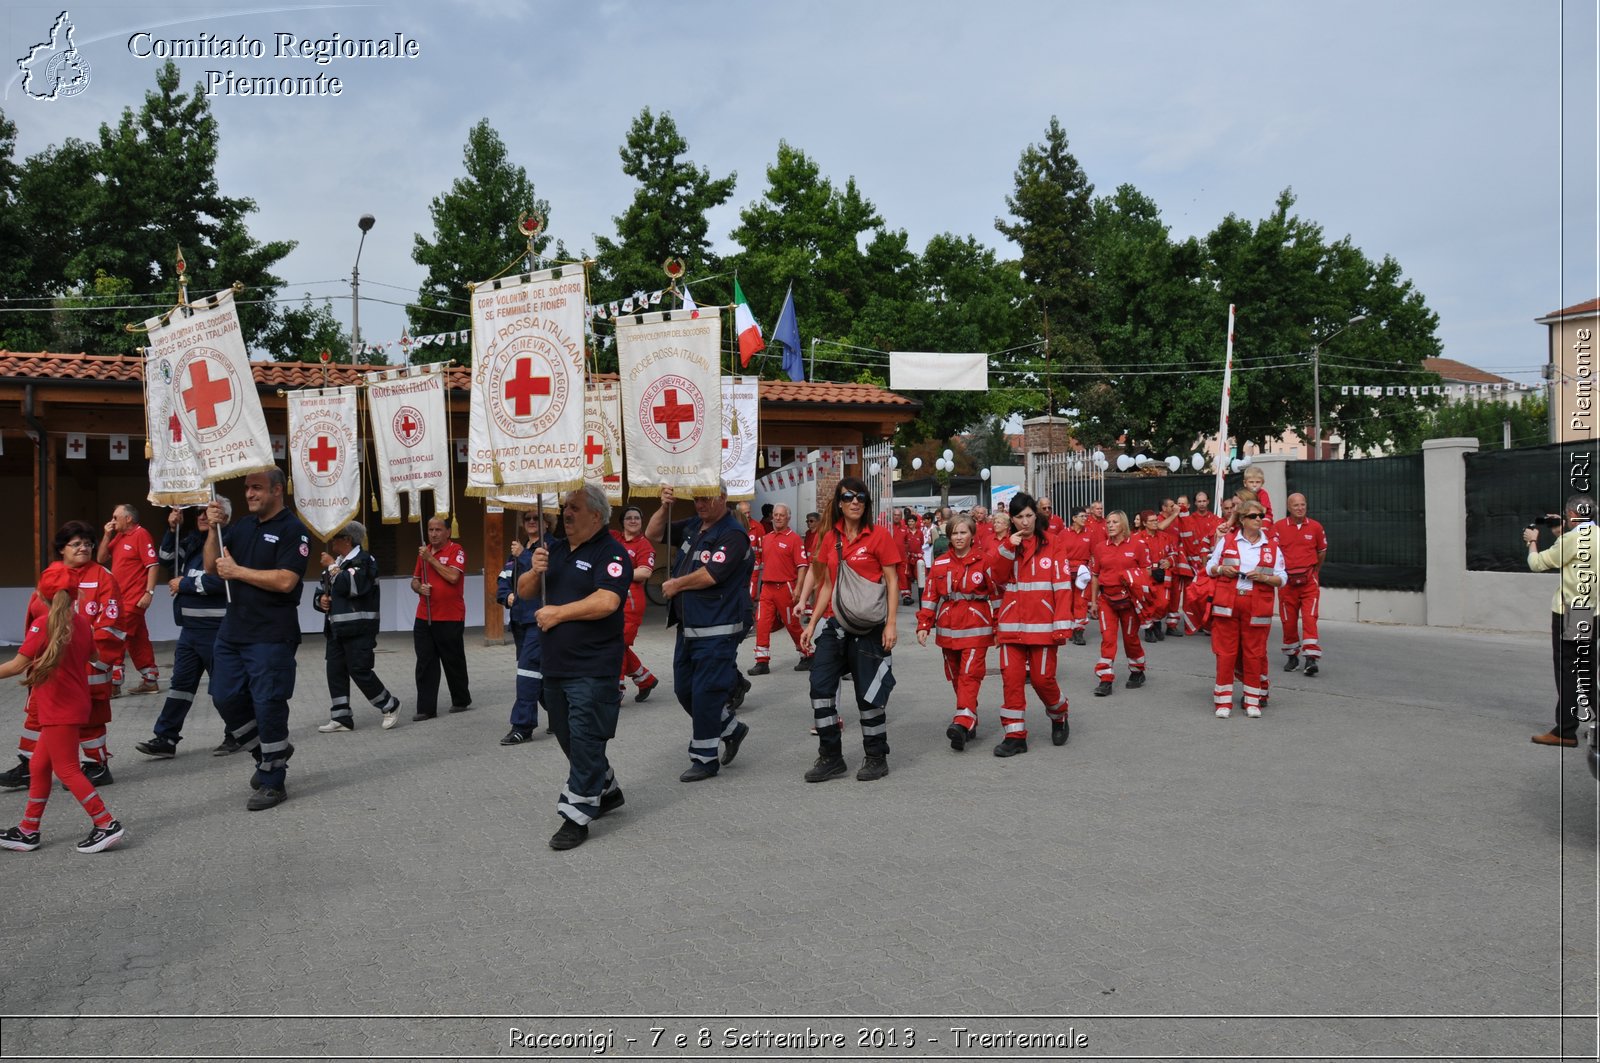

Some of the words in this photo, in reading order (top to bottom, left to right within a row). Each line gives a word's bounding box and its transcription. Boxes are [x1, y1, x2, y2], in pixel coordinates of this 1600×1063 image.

[534, 288, 546, 299] DEL
[534, 302, 538, 312] E
[195, 322, 207, 332] DEL
[672, 329, 682, 338] DEL
[154, 344, 176, 359] CROCE
[177, 334, 204, 349] ROSSA
[206, 321, 239, 340] ITALIANA
[512, 339, 551, 356] GINEVRA
[476, 338, 498, 385] CROCE
[498, 317, 540, 340] ROSSA
[542, 320, 584, 374] ITALIANA
[500, 351, 510, 364] DI
[550, 355, 560, 367] 22
[630, 353, 654, 382] CROCE
[652, 347, 679, 362] ROSSA
[552, 371, 566, 412] AGOSTO
[304, 410, 331, 422] ROSSA
[640, 393, 662, 444] CONVENZIONE
[652, 384, 660, 394] DI
[686, 382, 696, 393] 22
[692, 390, 704, 427] AGOSTO
[533, 411, 556, 432] 1864
[221, 438, 254, 454] LOCALE
[524, 444, 566, 455] LOCALE
[569, 443, 578, 452] DI
[471, 462, 506, 474] BORO
[520, 456, 582, 470] DALMAZZO
